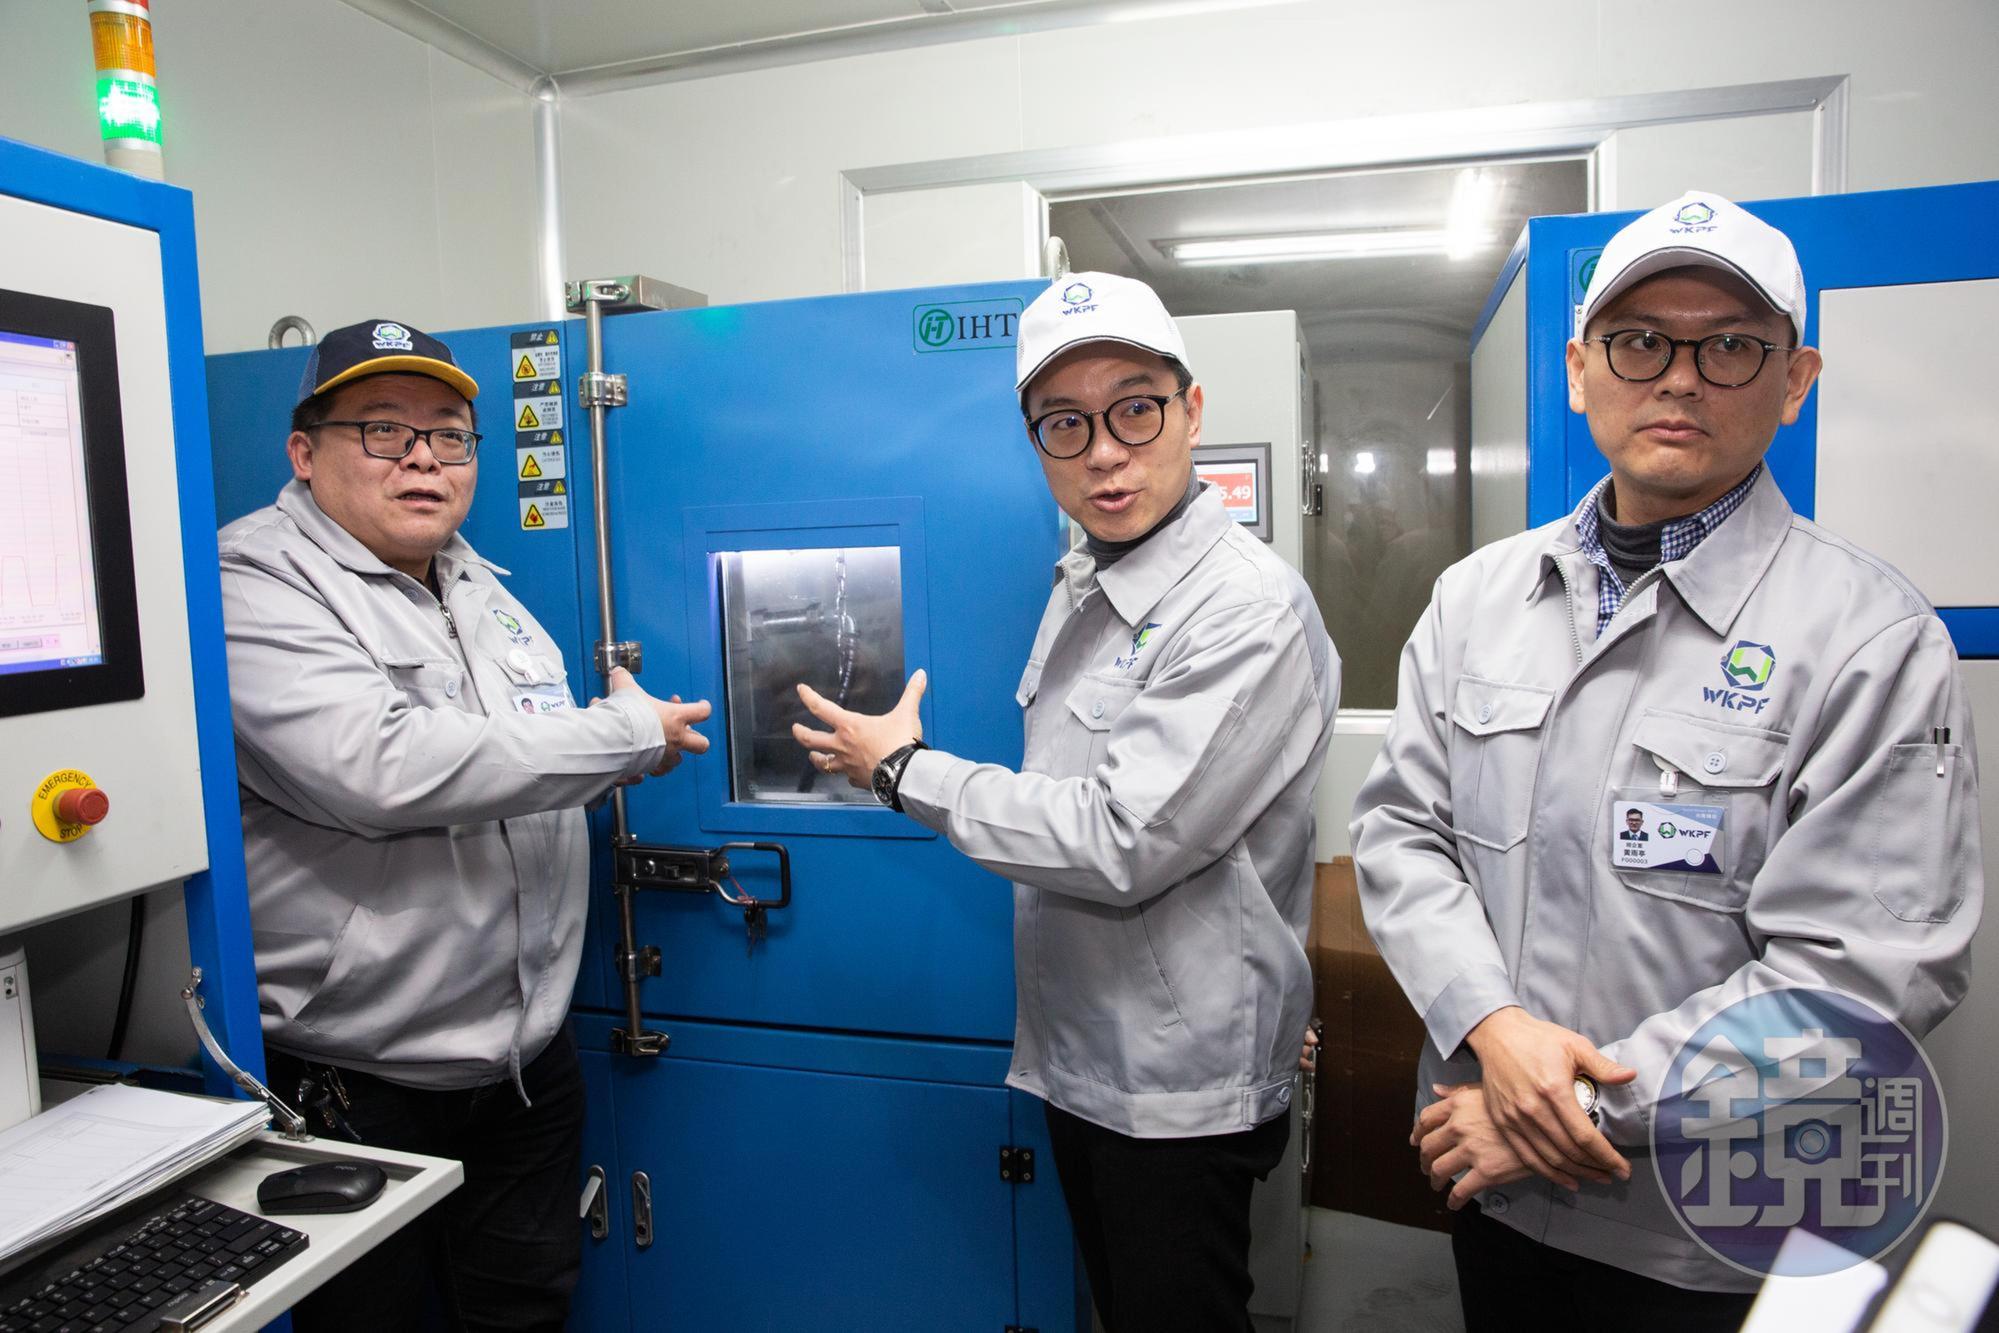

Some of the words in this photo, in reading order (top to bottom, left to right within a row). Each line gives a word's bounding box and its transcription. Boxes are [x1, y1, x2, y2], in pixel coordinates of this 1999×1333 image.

[1062, 304, 1098, 316] WKPF
[957, 312, 1018, 340] IHT
[1703, 686, 1770, 714] WKPF
[38, 772, 92, 800] EMERGENCY
[1678, 829, 1712, 839] WKPF
